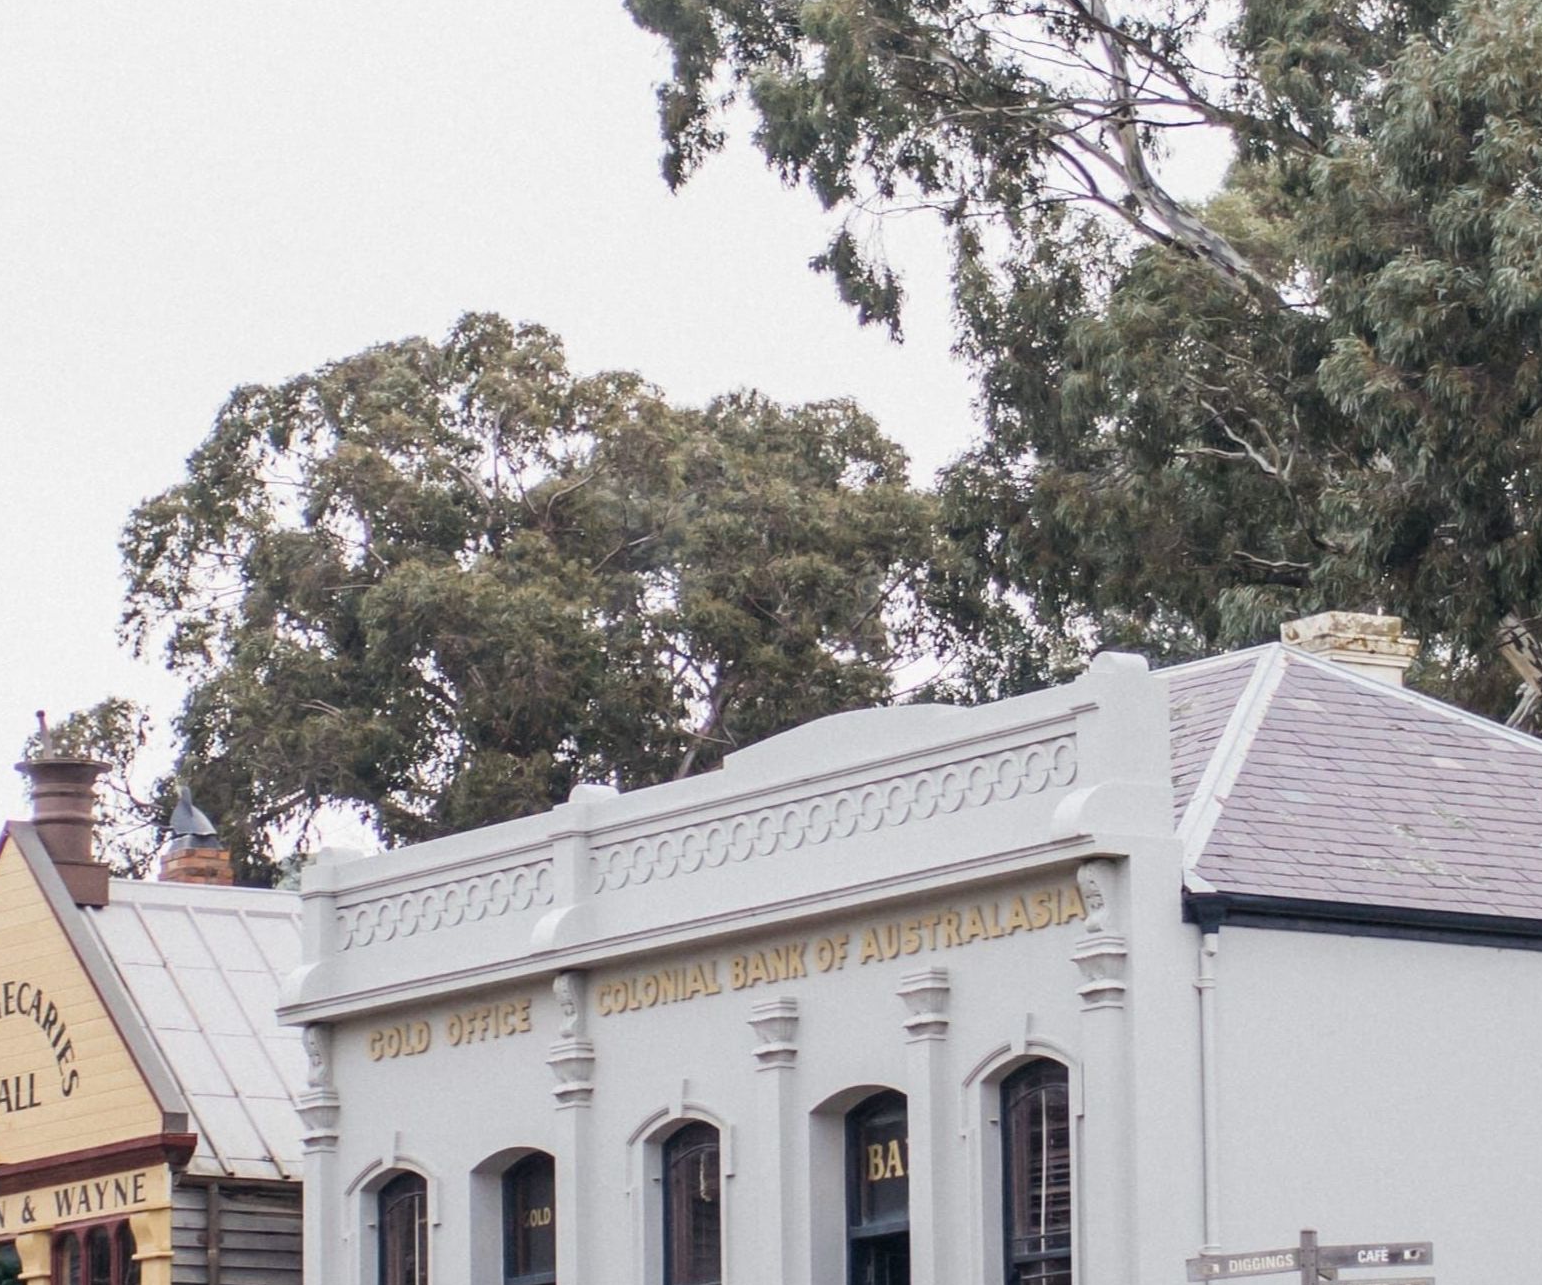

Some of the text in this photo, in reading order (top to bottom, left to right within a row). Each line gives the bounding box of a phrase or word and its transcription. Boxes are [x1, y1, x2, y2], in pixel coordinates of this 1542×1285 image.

[594, 885, 1089, 1017] COLONIAL BANK OF AUSTRALASIA
[370, 998, 533, 1062] GOLD OFFICE
[867, 1138, 908, 1182] BA
[21, 1195, 37, 1224] &
[55, 1172, 148, 1217] WAYNE
[524, 1207, 552, 1228] GOLD
[1228, 1253, 1295, 1274] DIGGINGS
[1357, 1245, 1389, 1264] CAFÉ
